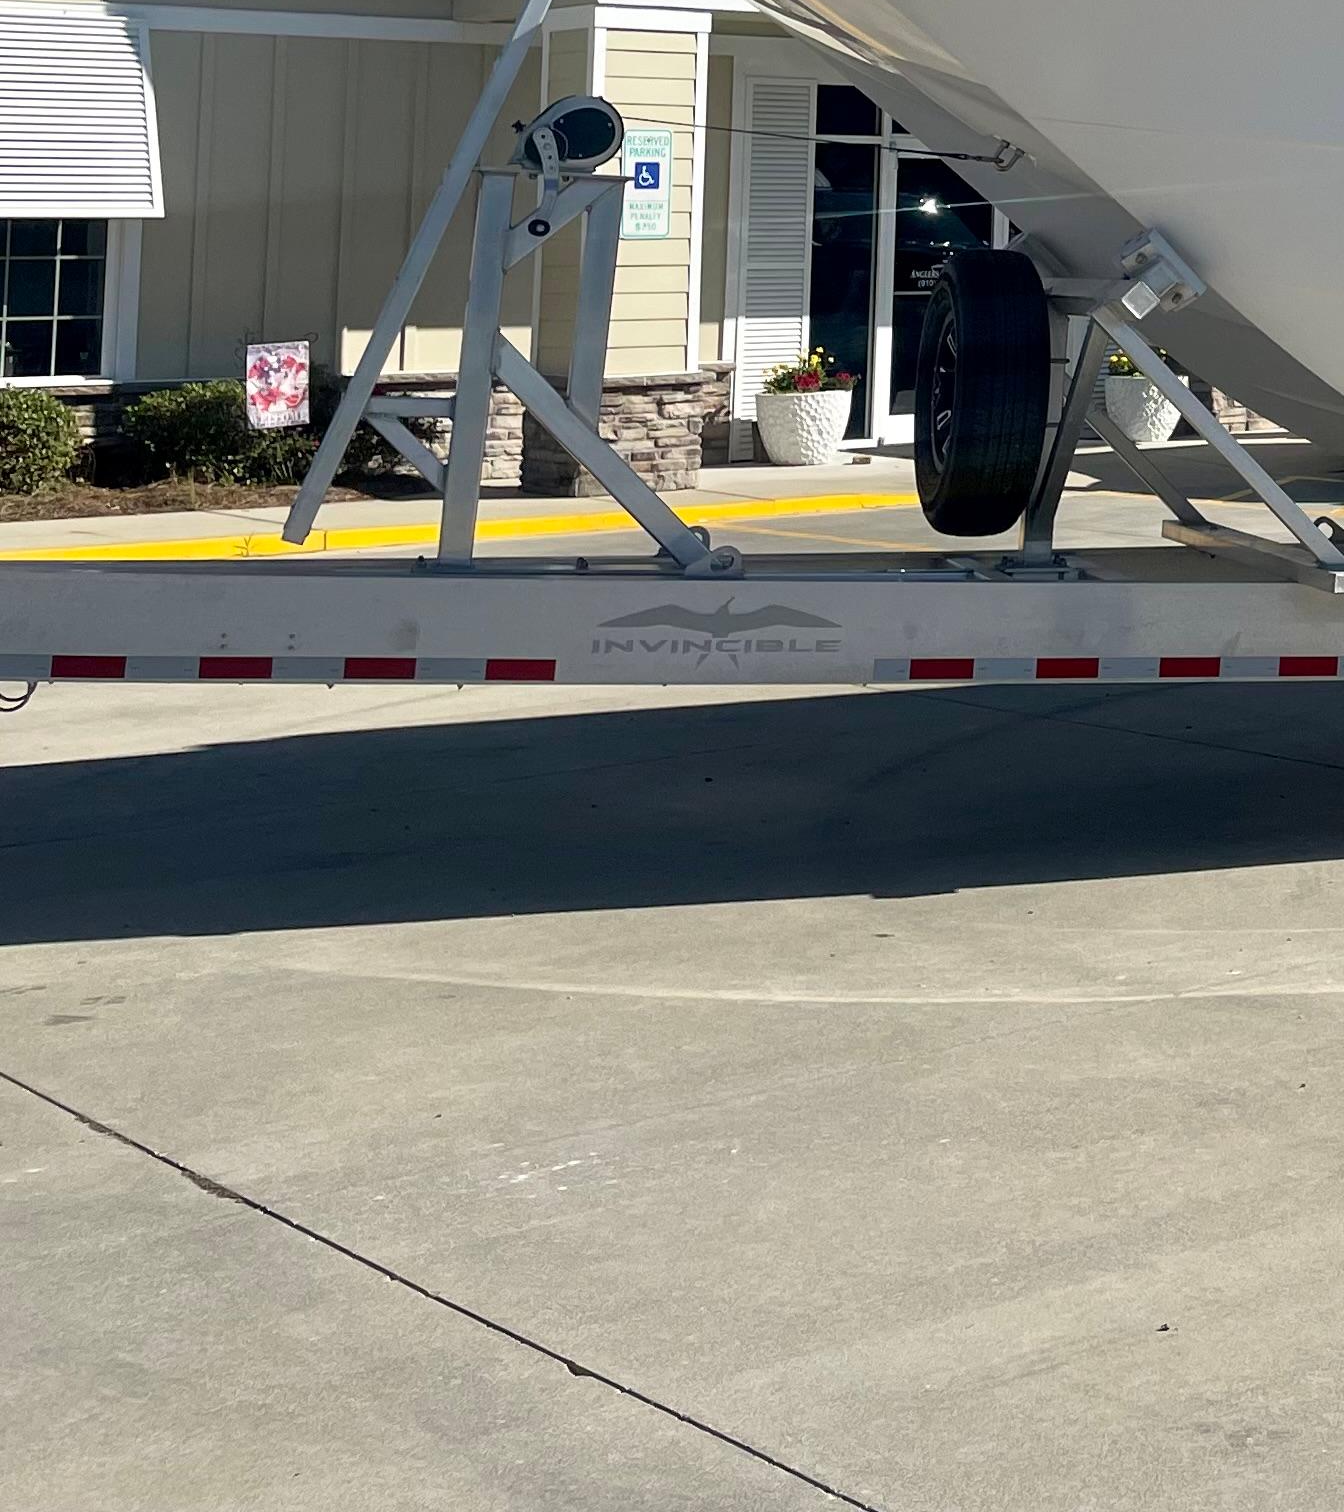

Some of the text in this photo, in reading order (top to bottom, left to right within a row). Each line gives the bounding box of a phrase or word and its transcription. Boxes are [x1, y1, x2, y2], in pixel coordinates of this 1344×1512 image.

[626, 136, 669, 146] RESERVED
[629, 148, 666, 158] PARKING
[591, 639, 843, 654] INVINCIBLE
